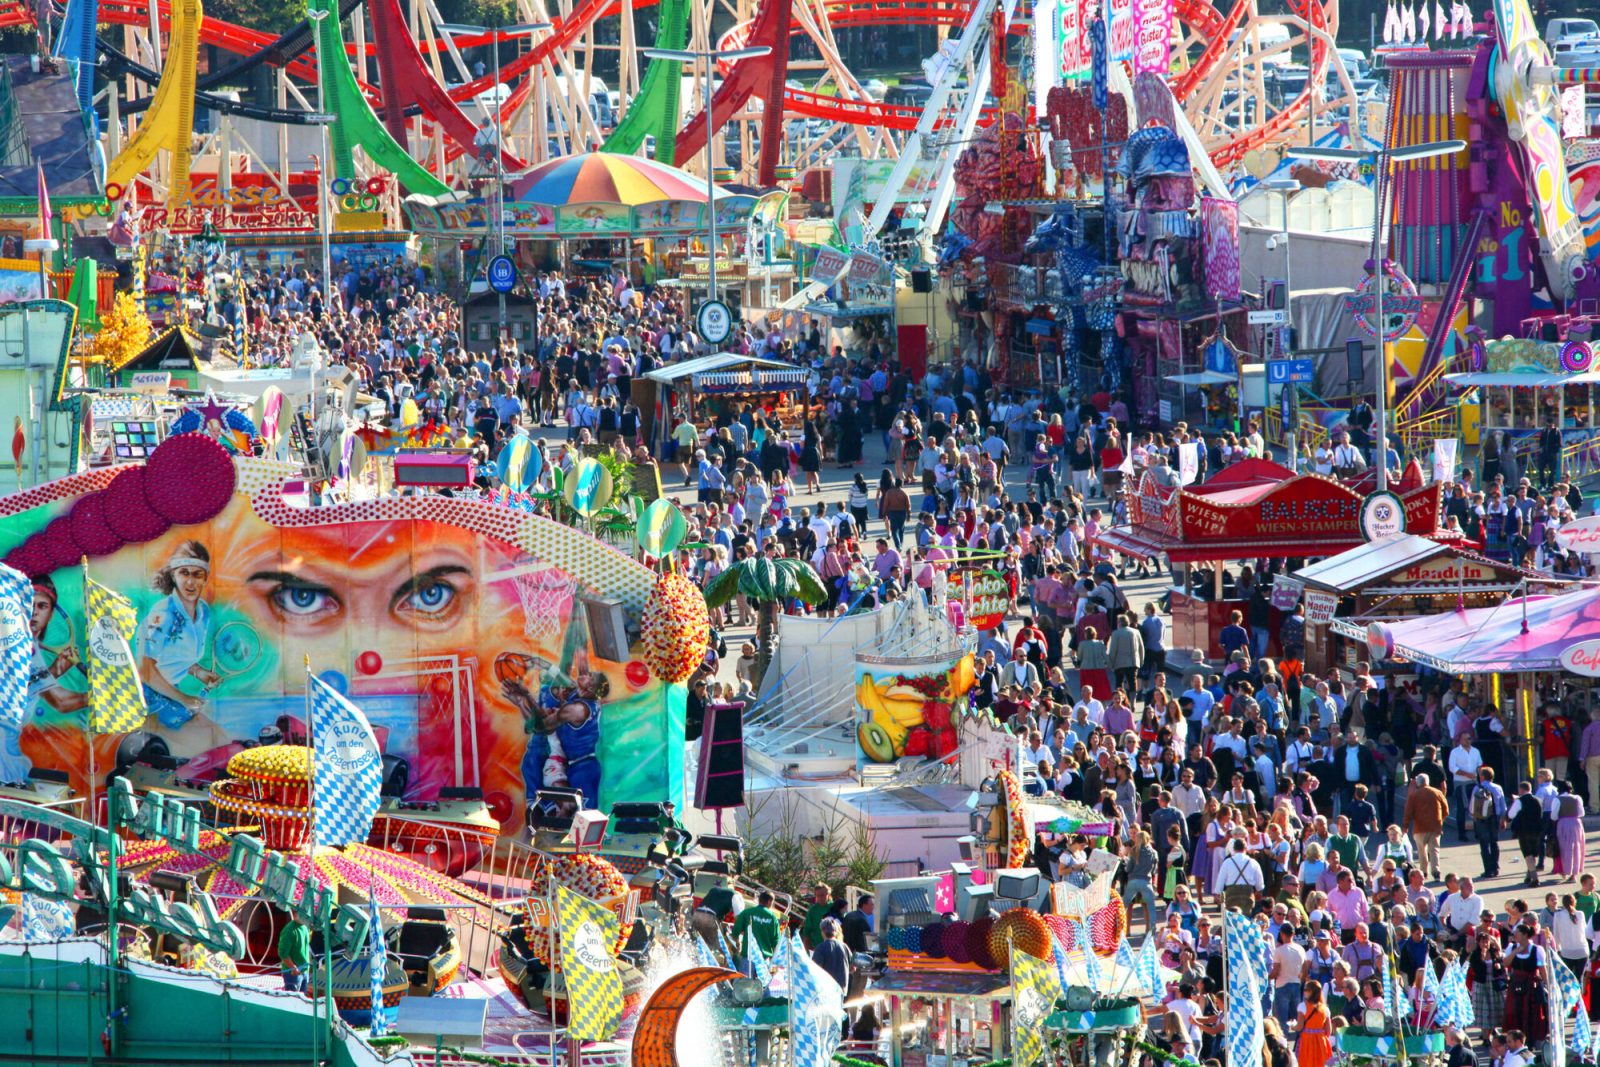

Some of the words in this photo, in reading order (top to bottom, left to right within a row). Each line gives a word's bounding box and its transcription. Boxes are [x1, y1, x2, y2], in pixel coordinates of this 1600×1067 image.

[174, 179, 284, 206] Kasse
[174, 207, 238, 229] Bath
[254, 206, 316, 228] Sohn
[816, 255, 846, 270] FOTO
[1502, 226, 1524, 281] 1
[852, 258, 880, 273] FOTO
[1478, 255, 1497, 282] 1
[1274, 365, 1286, 379] U
[1185, 514, 1225, 535] CAIPI
[1187, 503, 1229, 525] WIESN
[93, 637, 128, 662] Tegern
[333, 724, 368, 740] Rund
[336, 740, 347, 748] um
[348, 739, 364, 748] den
[326, 746, 374, 770] Tegernsee
[576, 943, 616, 969] Tegern
